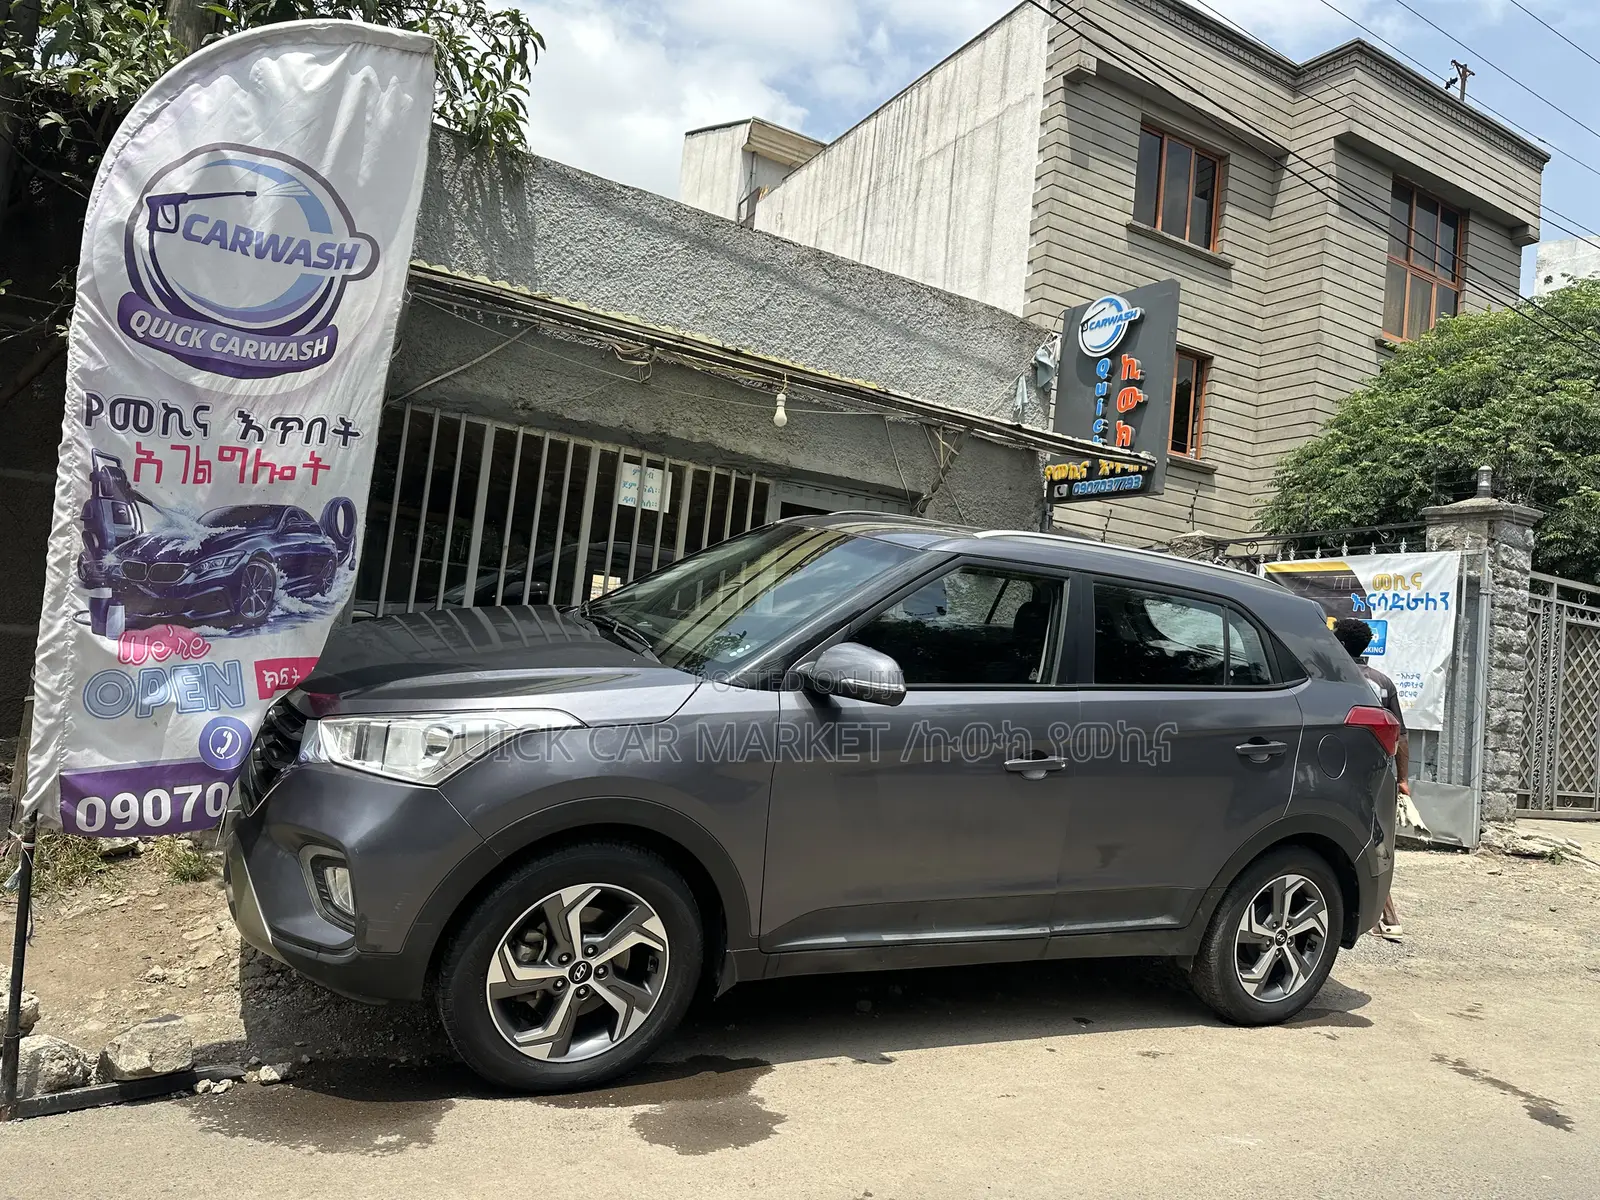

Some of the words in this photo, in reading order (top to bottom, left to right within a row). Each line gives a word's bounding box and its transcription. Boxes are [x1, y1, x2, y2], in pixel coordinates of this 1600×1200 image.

[182, 213, 361, 271] CARWASH
[129, 310, 204, 349] QUICK
[209, 332, 329, 361] CARWASH
[1088, 309, 1138, 331] CARWASH
[85, 392, 210, 437] የመኪና
[237, 410, 361, 447] እጥበት
[133, 441, 331, 485] አገልግሎት
[1044, 461, 1092, 481] የመኪና
[1072, 475, 1142, 495] 0907037793
[1351, 592, 1450, 611] እናሳድራለን
[1372, 572, 1422, 591] መኪና
[118, 625, 211, 665] We're
[83, 659, 245, 719] OPEN
